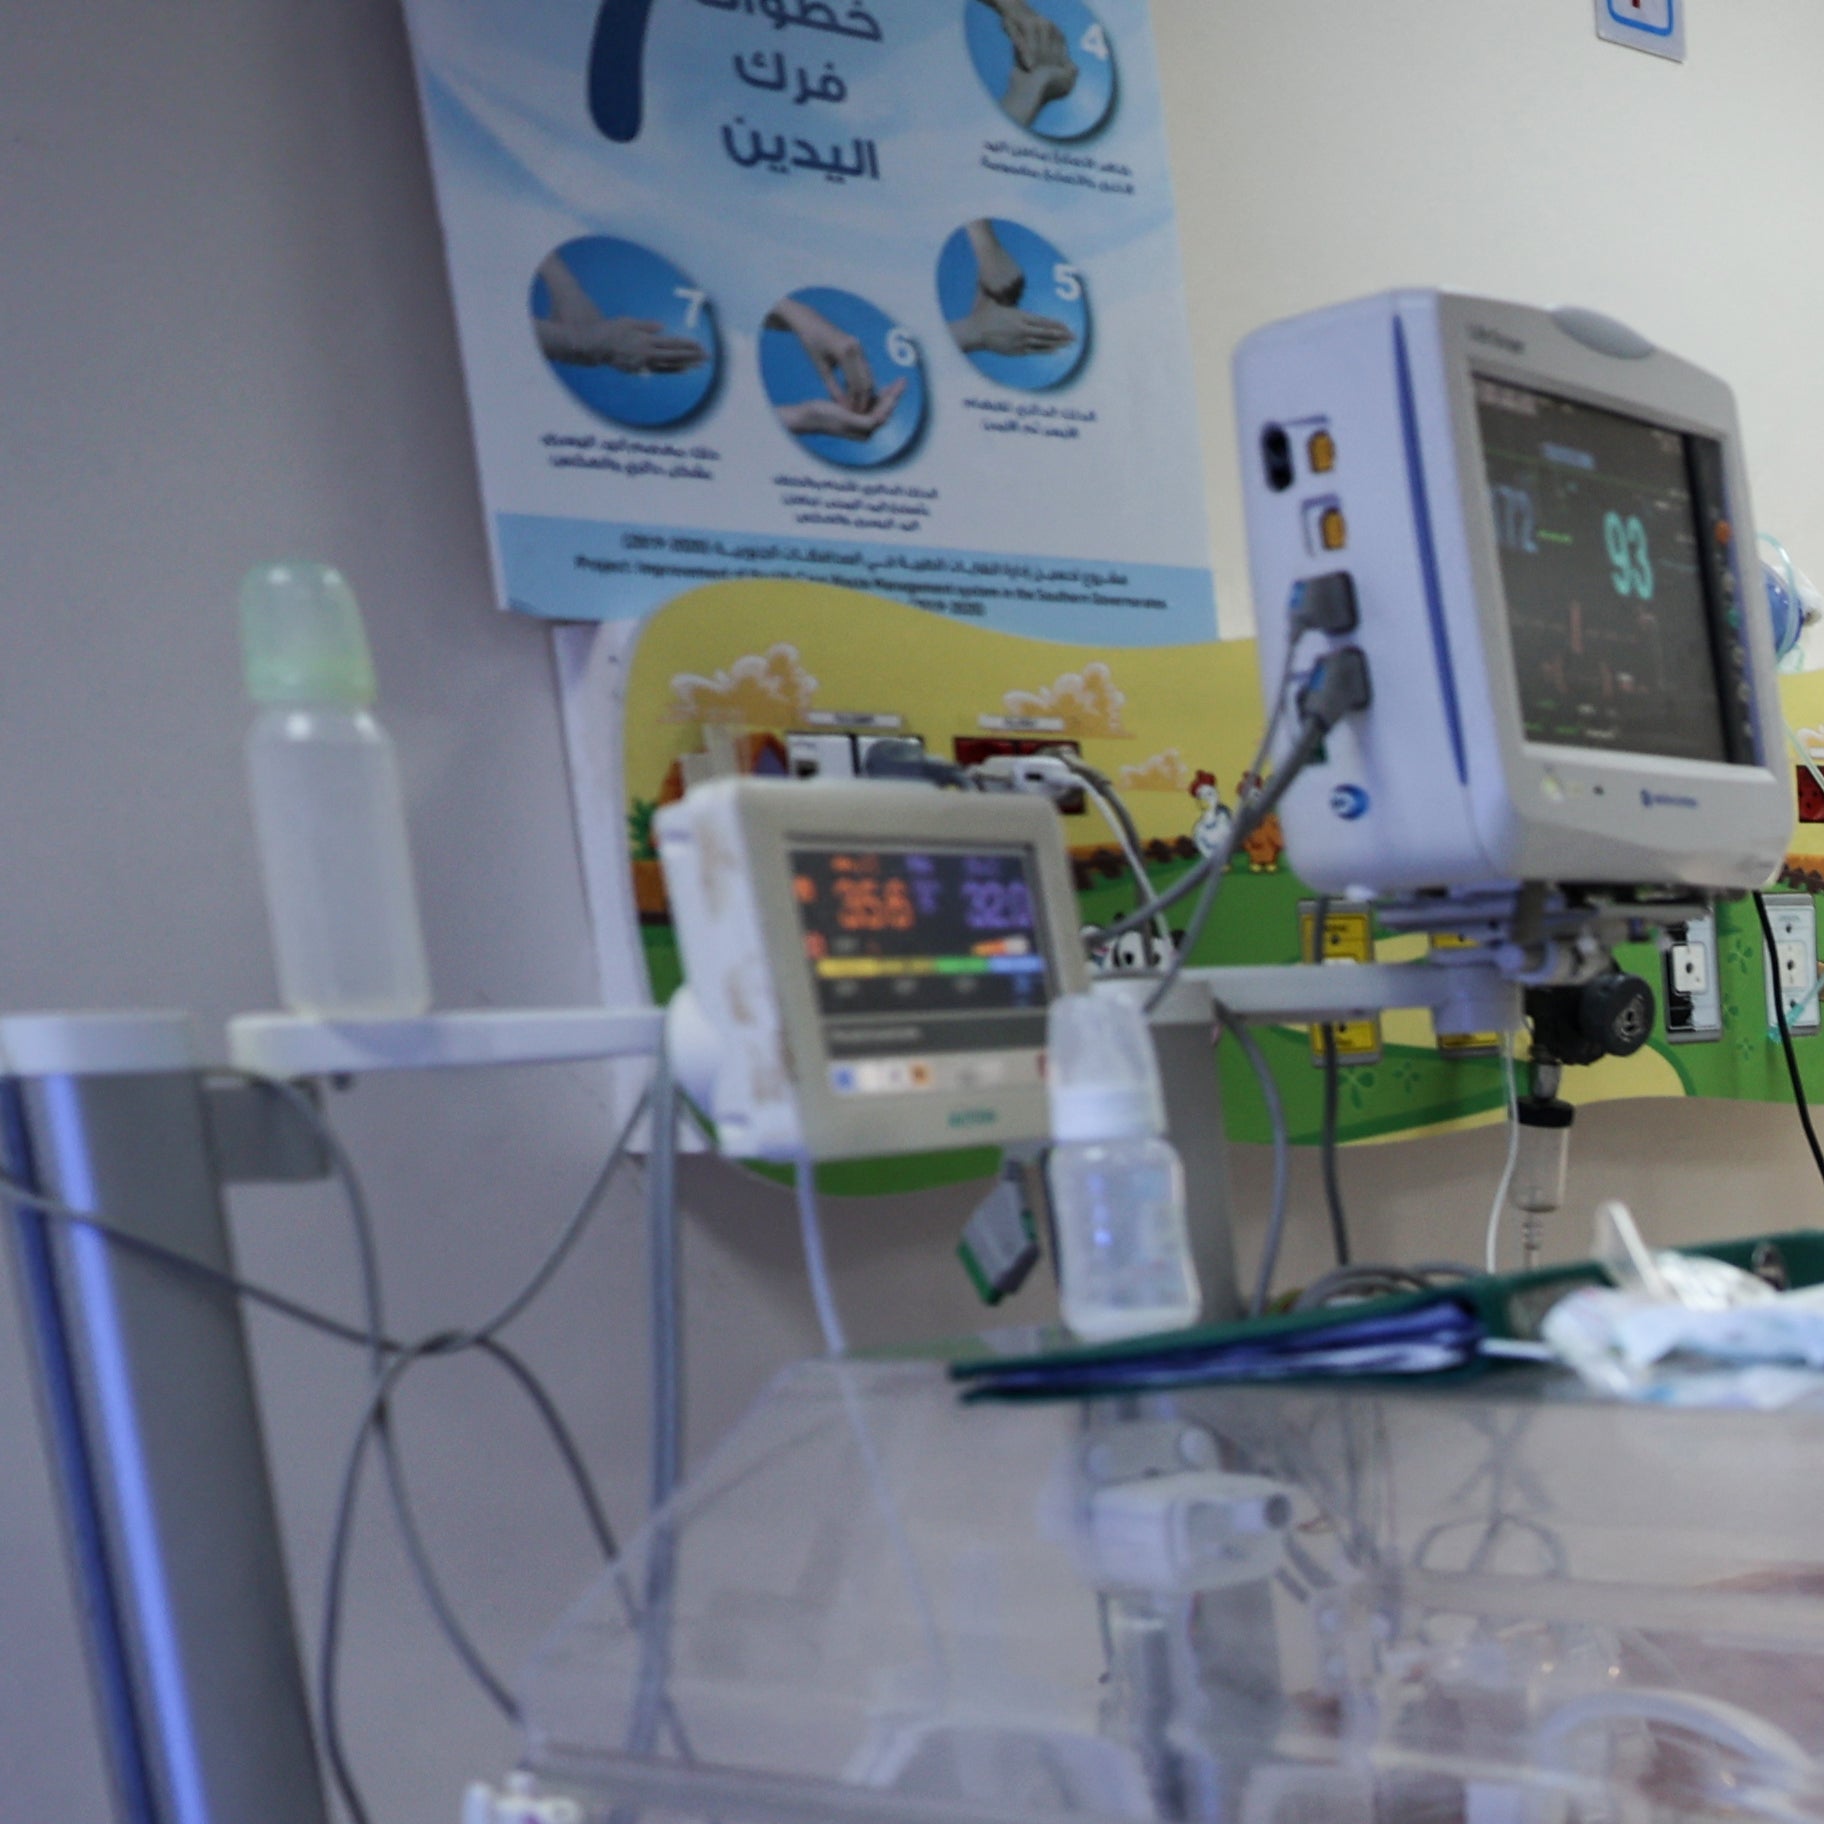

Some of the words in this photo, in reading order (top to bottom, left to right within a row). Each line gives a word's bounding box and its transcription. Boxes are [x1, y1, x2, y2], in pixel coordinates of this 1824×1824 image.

[1080, 25, 1108, 60] 4
[733, 48, 848, 105] فرك
[721, 114, 882, 184] اليدين
[1053, 263, 1081, 301] 5
[675, 287, 709, 329] 7
[886, 327, 915, 366] 6
[1602, 510, 1655, 601] 93
